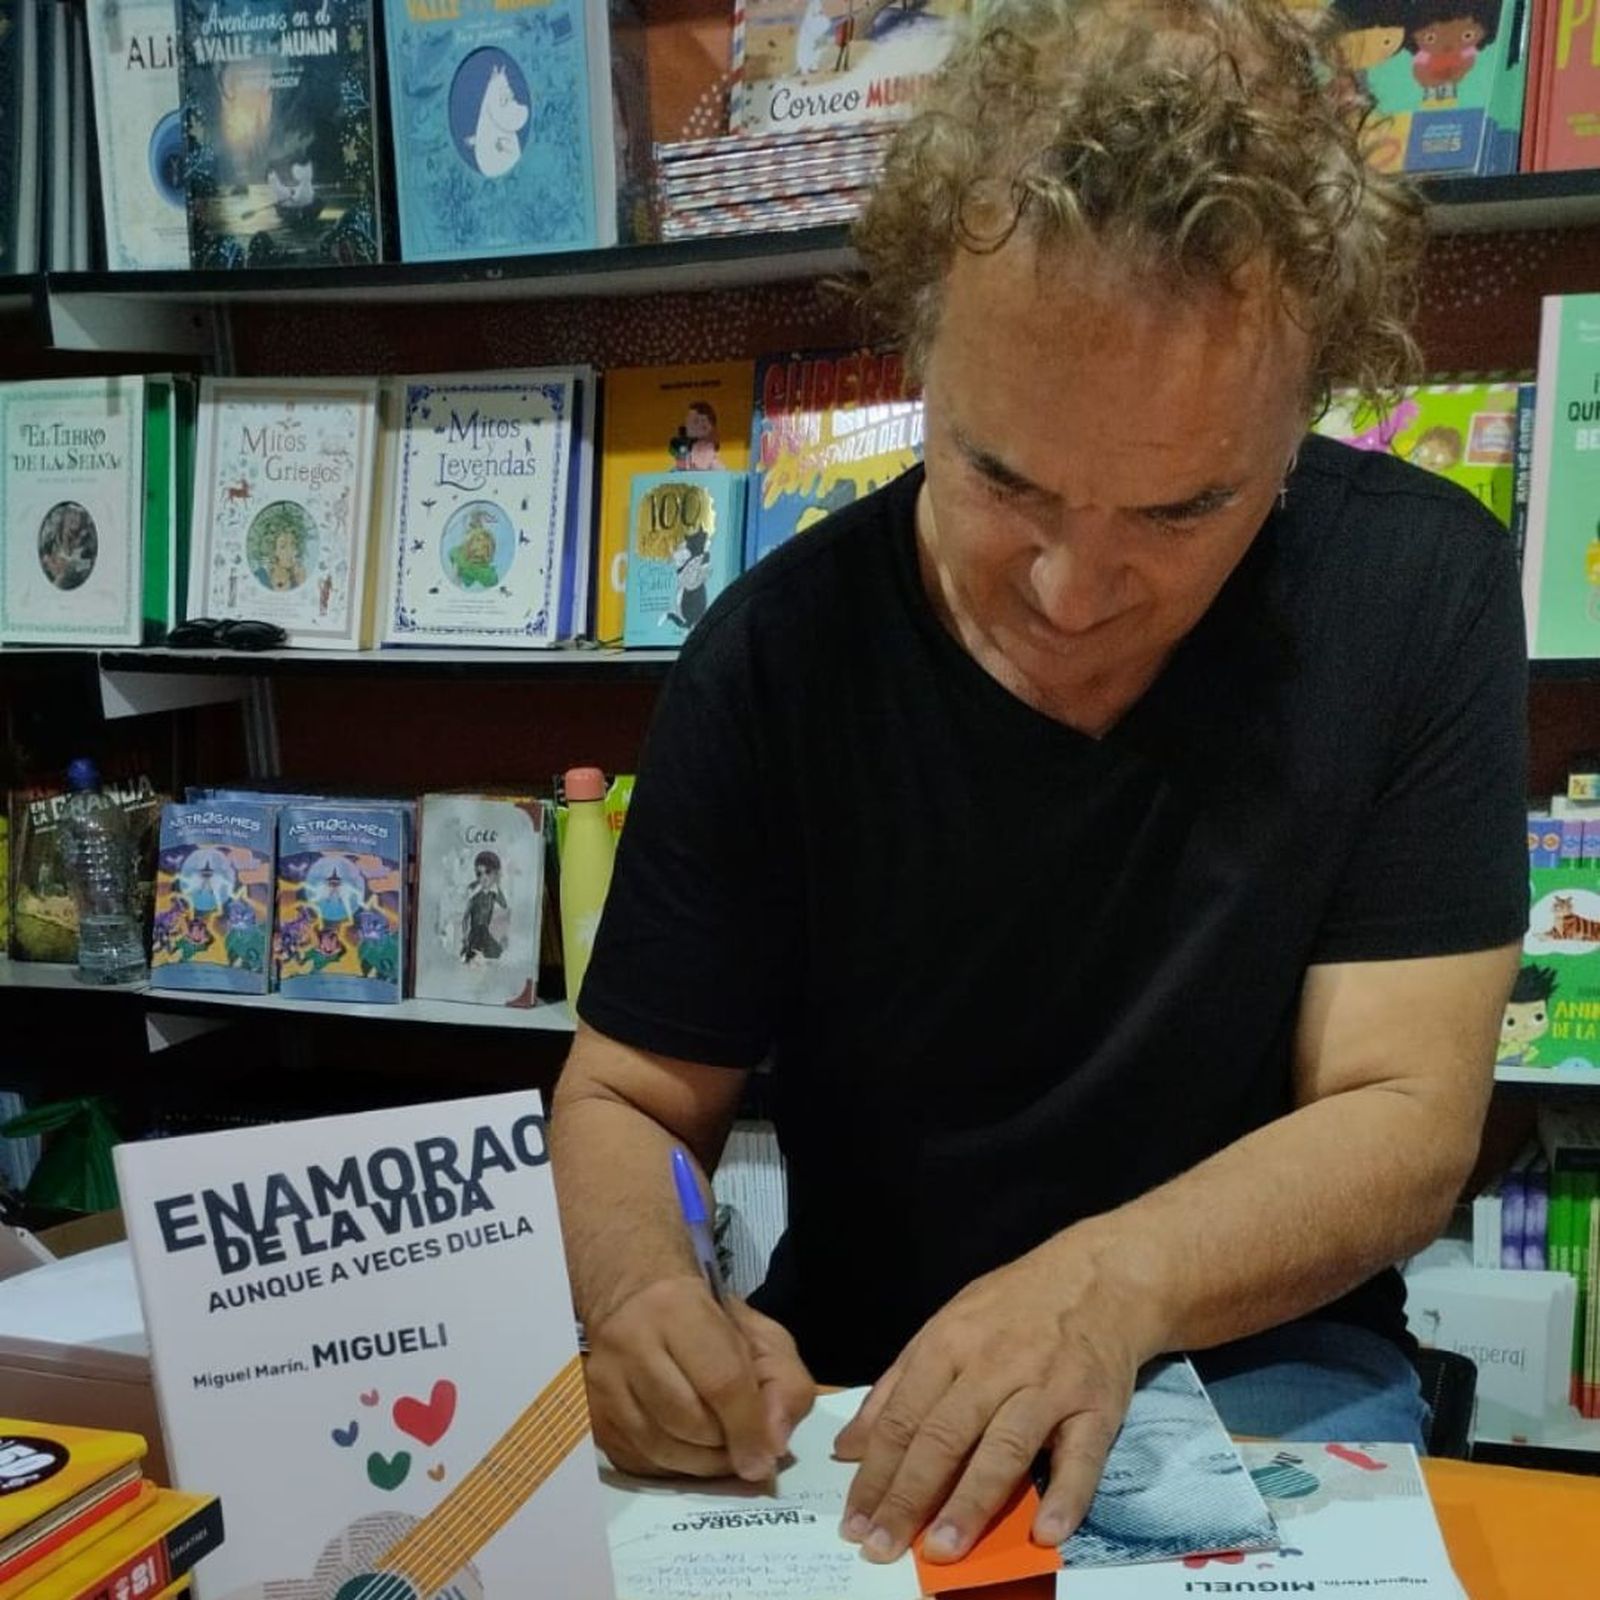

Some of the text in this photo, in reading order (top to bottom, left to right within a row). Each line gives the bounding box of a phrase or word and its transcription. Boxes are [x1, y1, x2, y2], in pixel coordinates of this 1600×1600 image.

[202, 2, 288, 35] Aventuras
[292, 10, 309, 27] en
[204, 34, 251, 62] VALLE
[280, 28, 338, 57] MUMIN
[770, 88, 860, 122] Correo
[240, 426, 307, 458] Mitos
[449, 409, 520, 451] Mitos
[265, 455, 341, 491] Griegos
[434, 449, 536, 492] Leyendas
[650, 490, 702, 532] 100
[154, 1114, 550, 1253] ENAMORAO
[213, 1178, 496, 1275] DE LA VIDA
[208, 1215, 534, 1313] AUNQUE A VECES DUELA
[193, 1367, 251, 1388] Miguel
[312, 1322, 449, 1369] MIGUELI
[1185, 1580, 1316, 1592] MIGUELI
